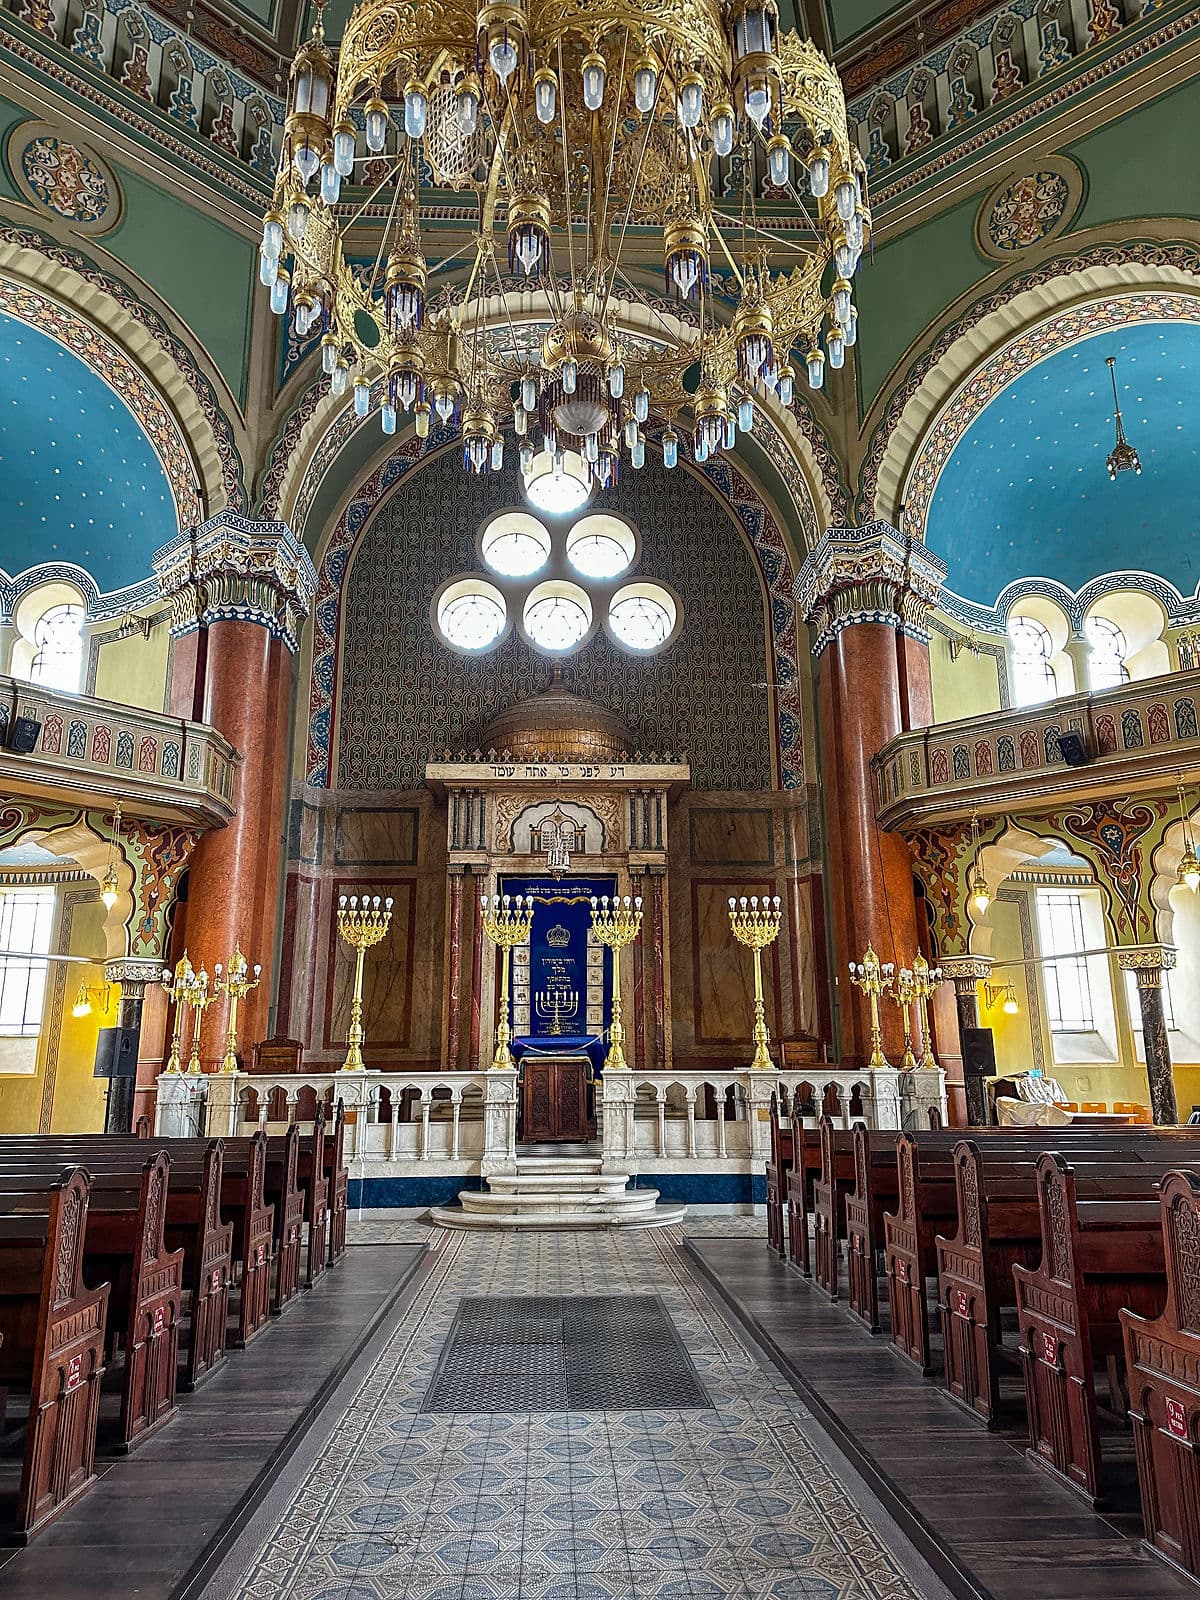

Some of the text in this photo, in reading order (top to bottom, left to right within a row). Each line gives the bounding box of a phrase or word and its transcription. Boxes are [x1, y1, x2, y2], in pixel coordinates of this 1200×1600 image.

[489, 765, 625, 778] דע לפני מי אתה עומד
